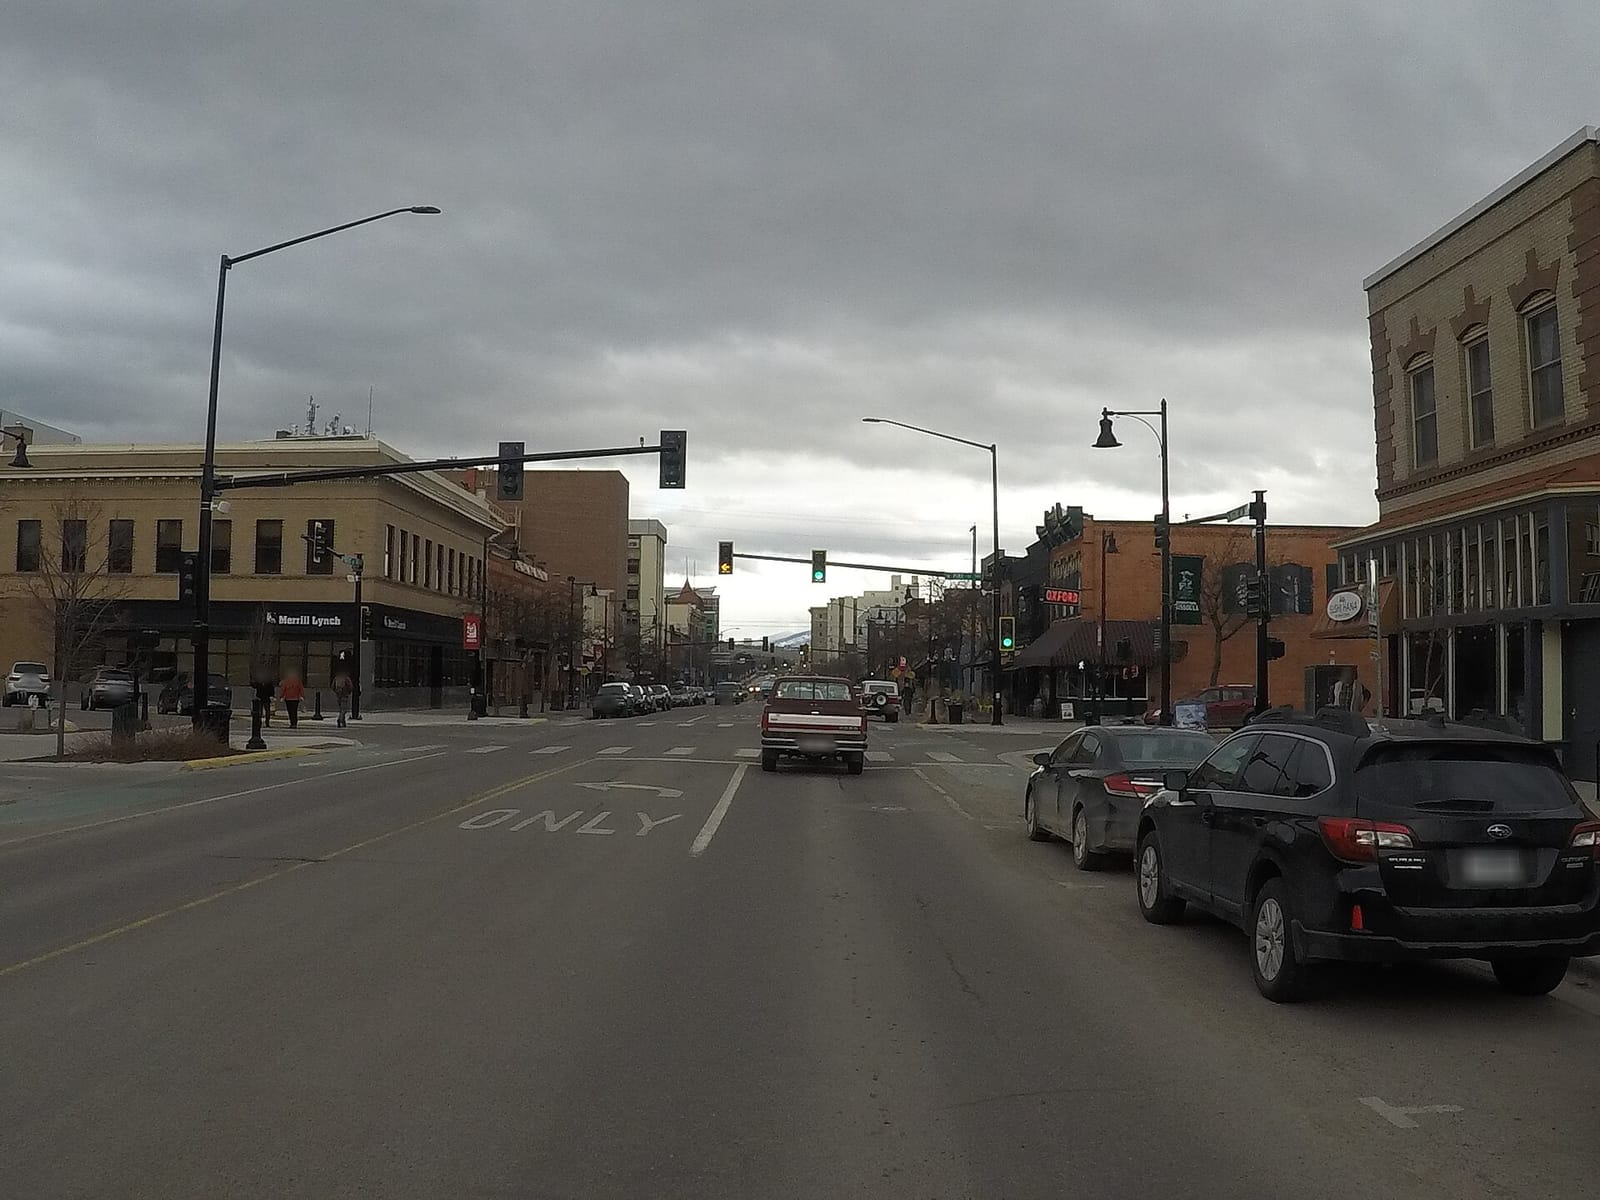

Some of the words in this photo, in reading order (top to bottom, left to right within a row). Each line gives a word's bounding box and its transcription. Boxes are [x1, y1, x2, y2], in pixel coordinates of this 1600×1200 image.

[1046, 589, 1078, 604] OXFORD
[278, 615, 310, 625] Merrill
[311, 615, 342, 627] Lynch
[458, 808, 683, 836] ONLY
